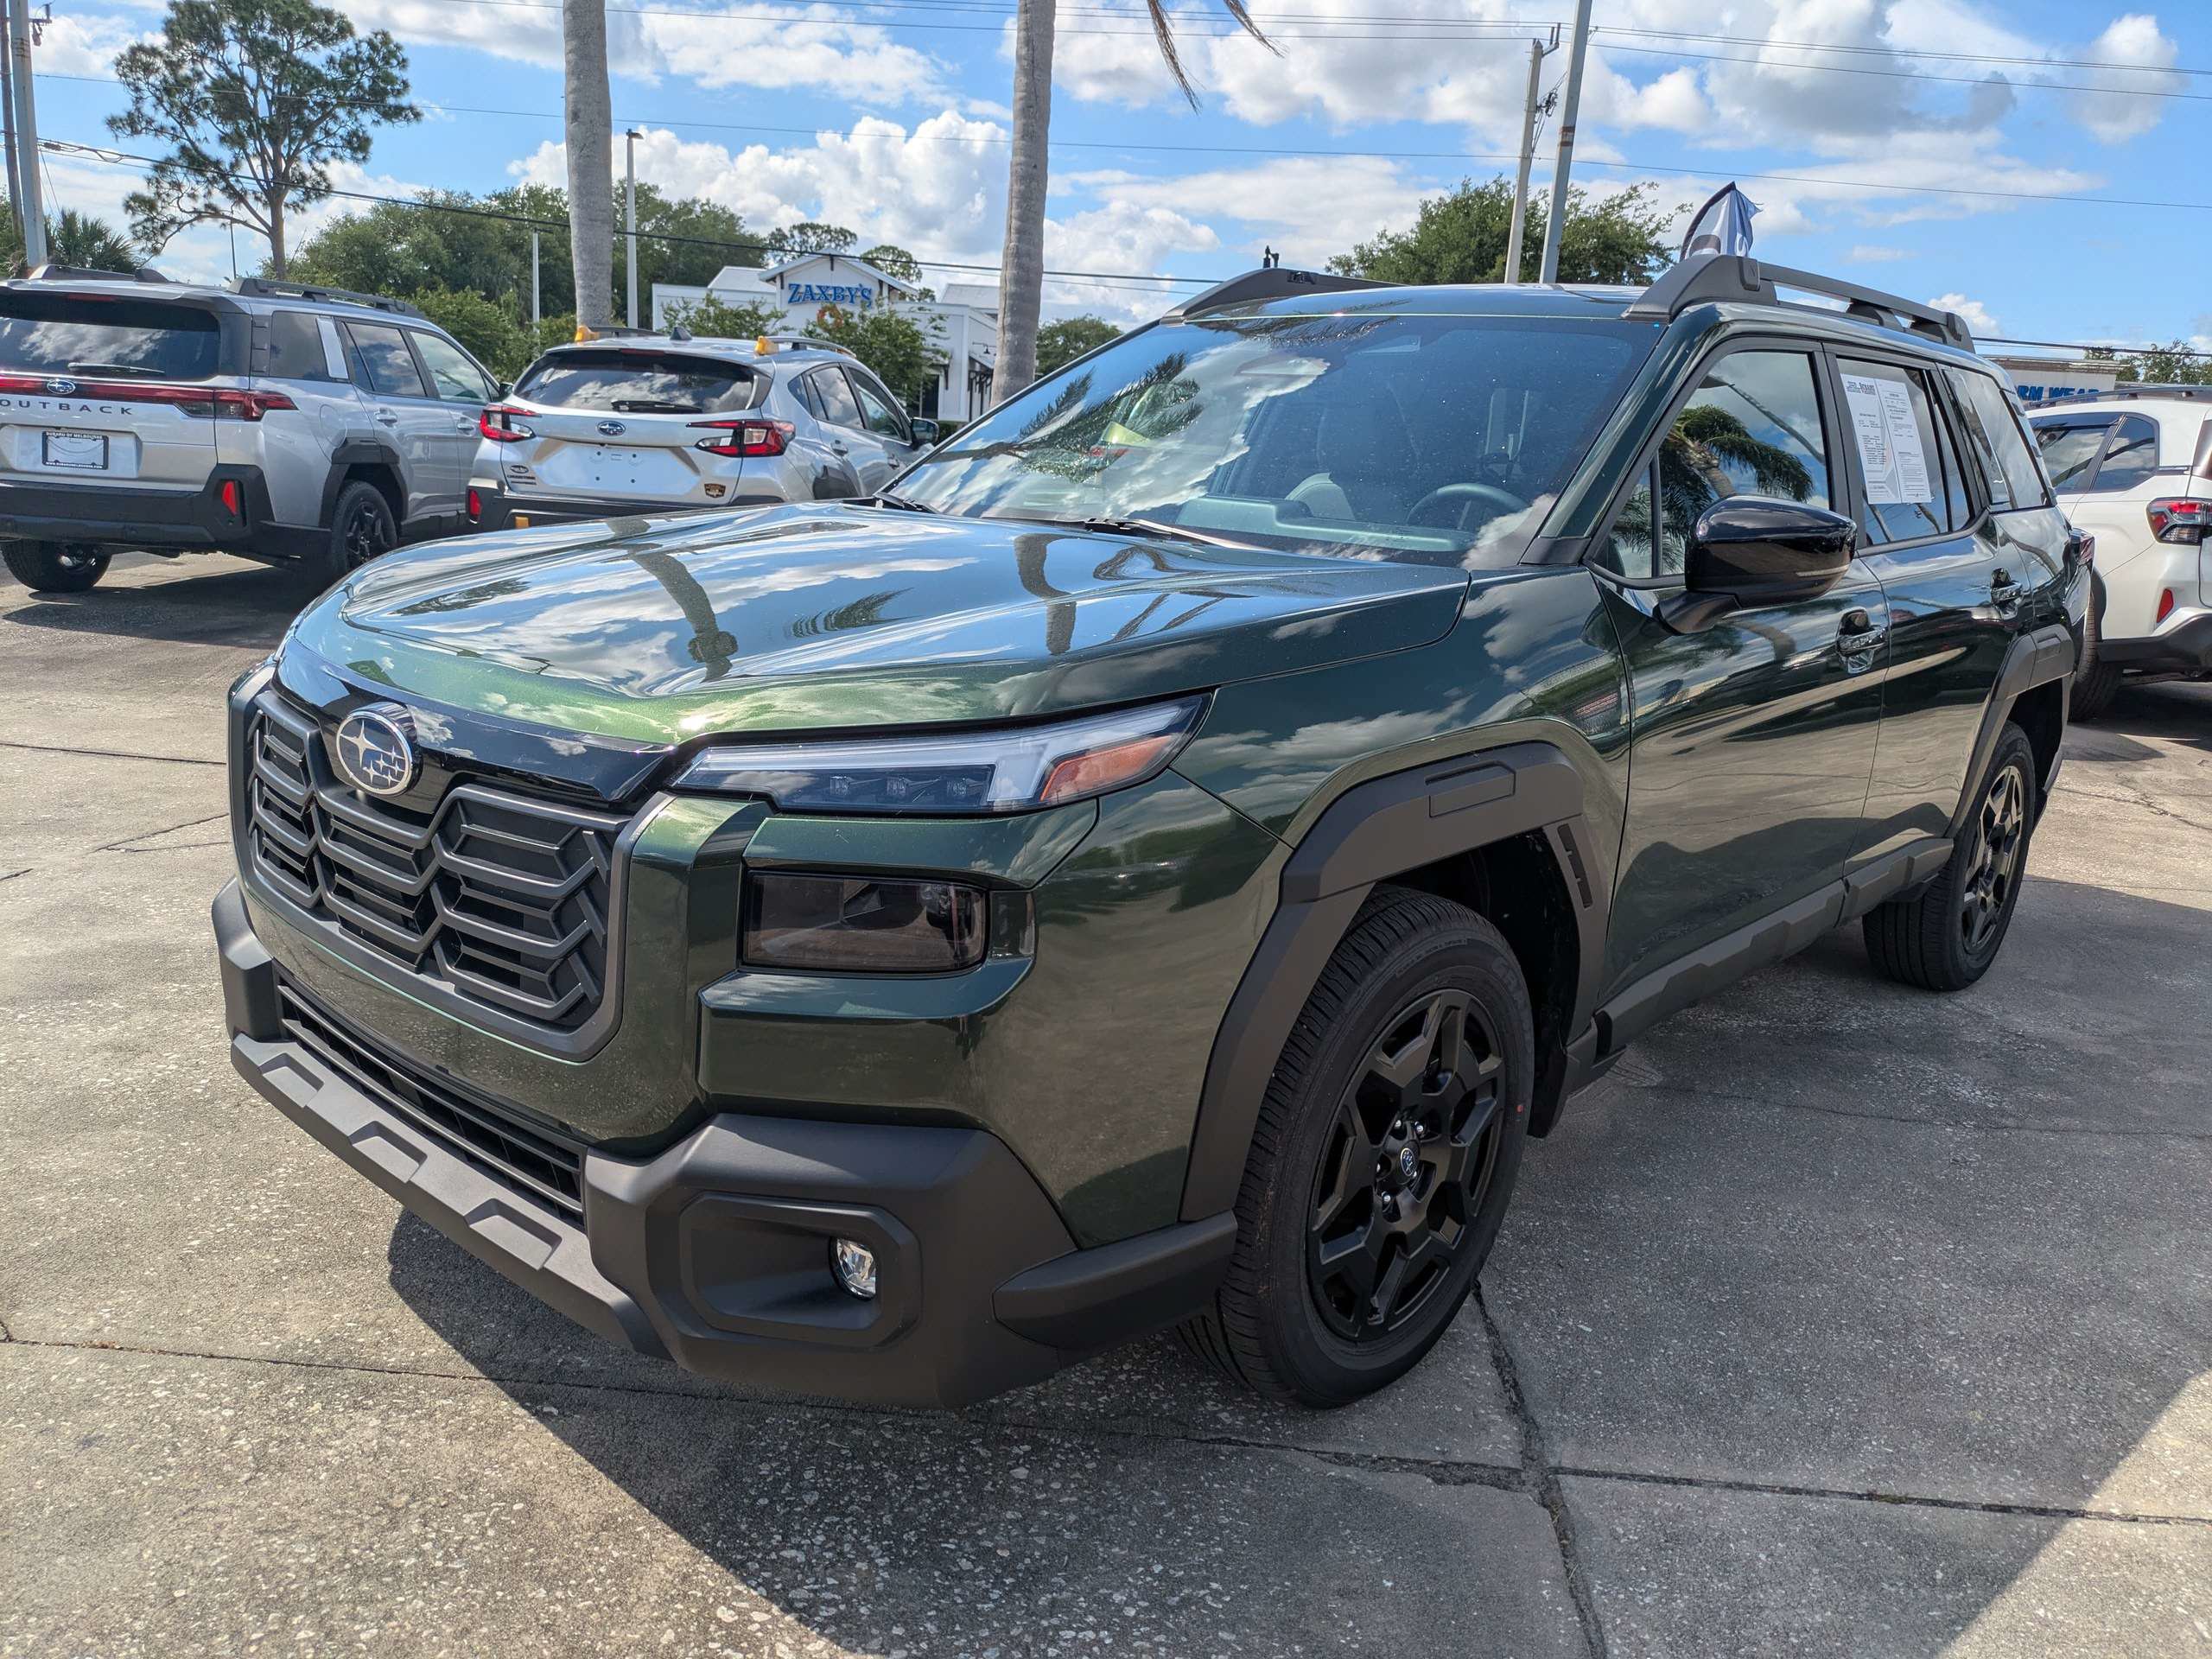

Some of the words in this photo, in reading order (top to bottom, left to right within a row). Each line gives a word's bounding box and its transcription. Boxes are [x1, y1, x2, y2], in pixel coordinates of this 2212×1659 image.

[788, 283, 872, 308] ZAXBY'S
[2016, 385, 2044, 401] RM
[0, 398, 132, 415] OUTBACK
